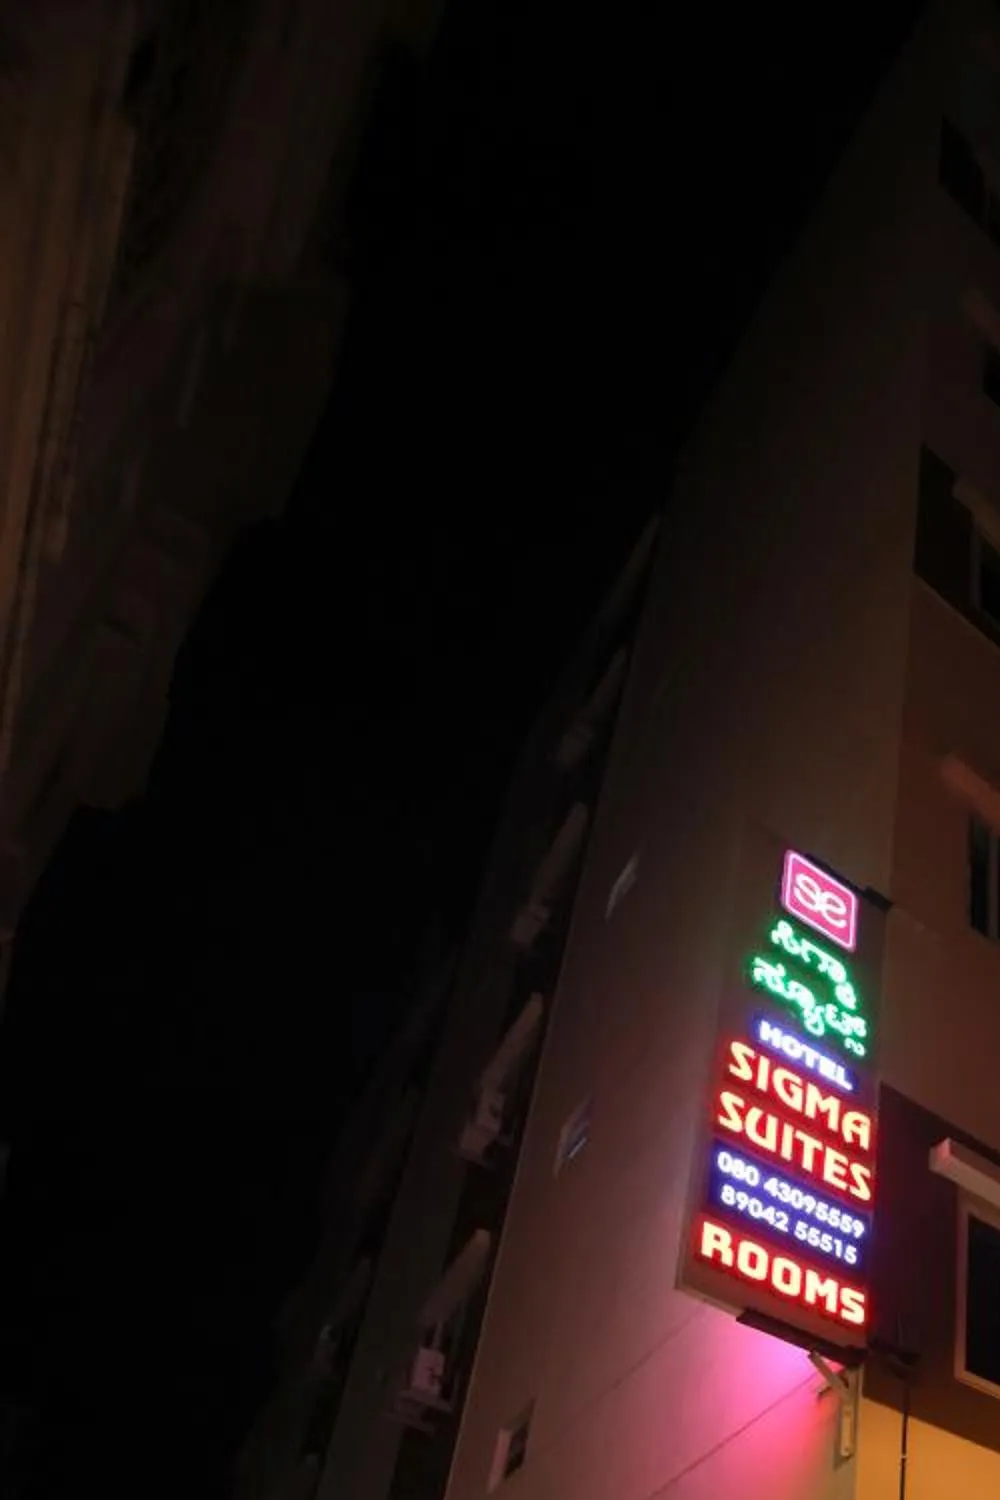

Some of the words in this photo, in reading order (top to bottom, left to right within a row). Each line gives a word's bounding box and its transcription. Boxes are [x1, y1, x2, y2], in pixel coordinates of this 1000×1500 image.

[728, 1040, 872, 1151] SIGMA
[759, 1019, 854, 1091] HOTEL
[717, 1090, 872, 1201] SUITES
[717, 1151, 760, 1187] 080
[763, 1177, 866, 1239] 43095559
[720, 1184, 789, 1233] 89042
[794, 1220, 858, 1265] 55515
[700, 1220, 866, 1325] ROOMS
